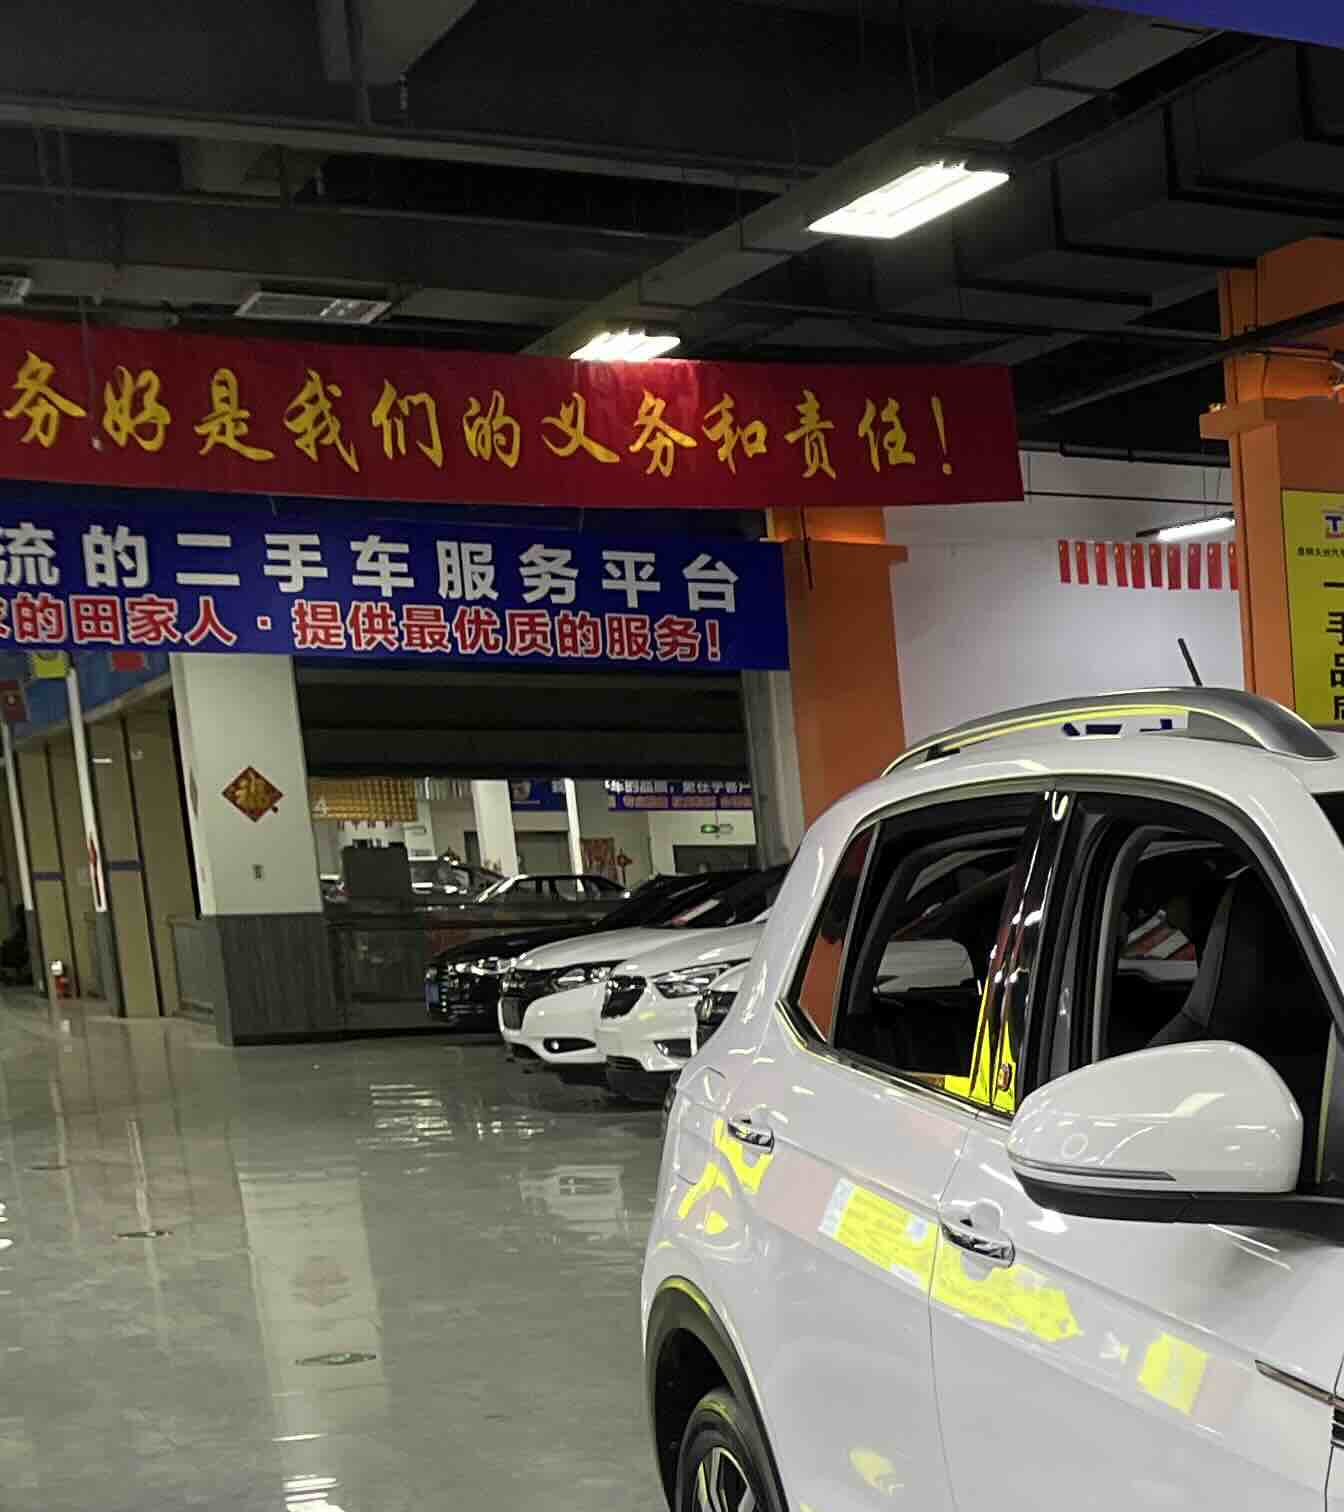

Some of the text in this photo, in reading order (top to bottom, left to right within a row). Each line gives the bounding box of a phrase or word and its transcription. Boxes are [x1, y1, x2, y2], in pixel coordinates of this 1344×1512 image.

[0, 522, 739, 613] 流的二手车服务平台
